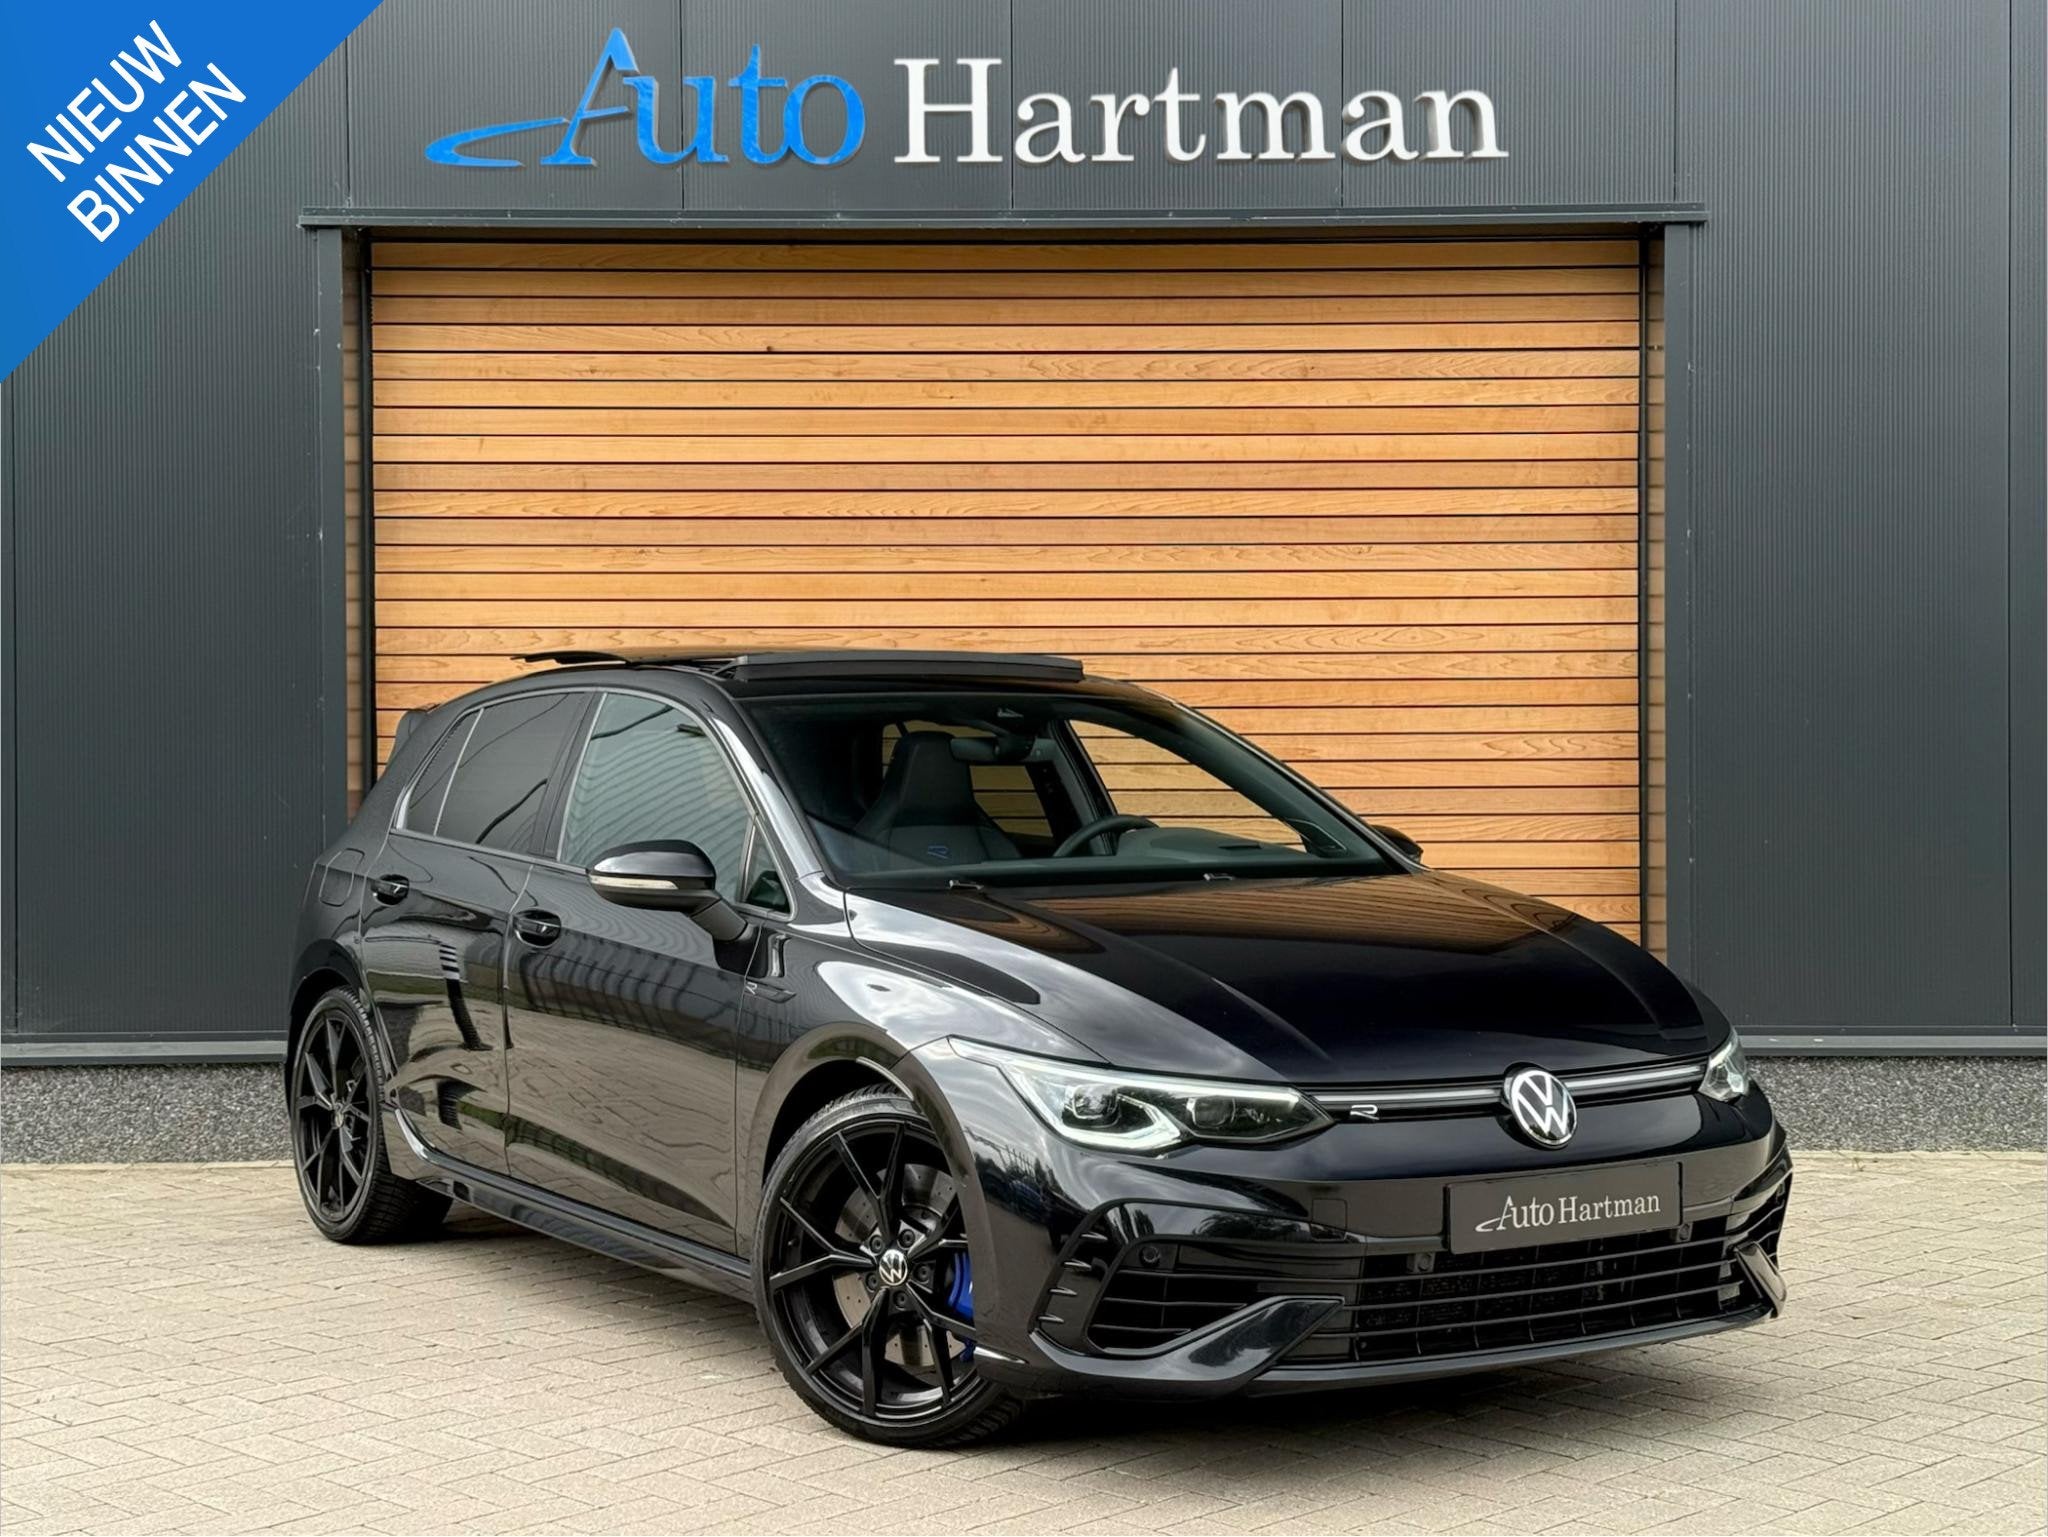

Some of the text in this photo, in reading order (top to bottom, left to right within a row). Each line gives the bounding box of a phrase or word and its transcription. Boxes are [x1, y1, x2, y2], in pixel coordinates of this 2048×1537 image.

[424, 27, 1510, 167] Auto Hartman
[1350, 1104, 1380, 1121] R
[1511, 1070, 1577, 1146] VW
[1474, 1194, 1662, 1232] Auto Hartman
